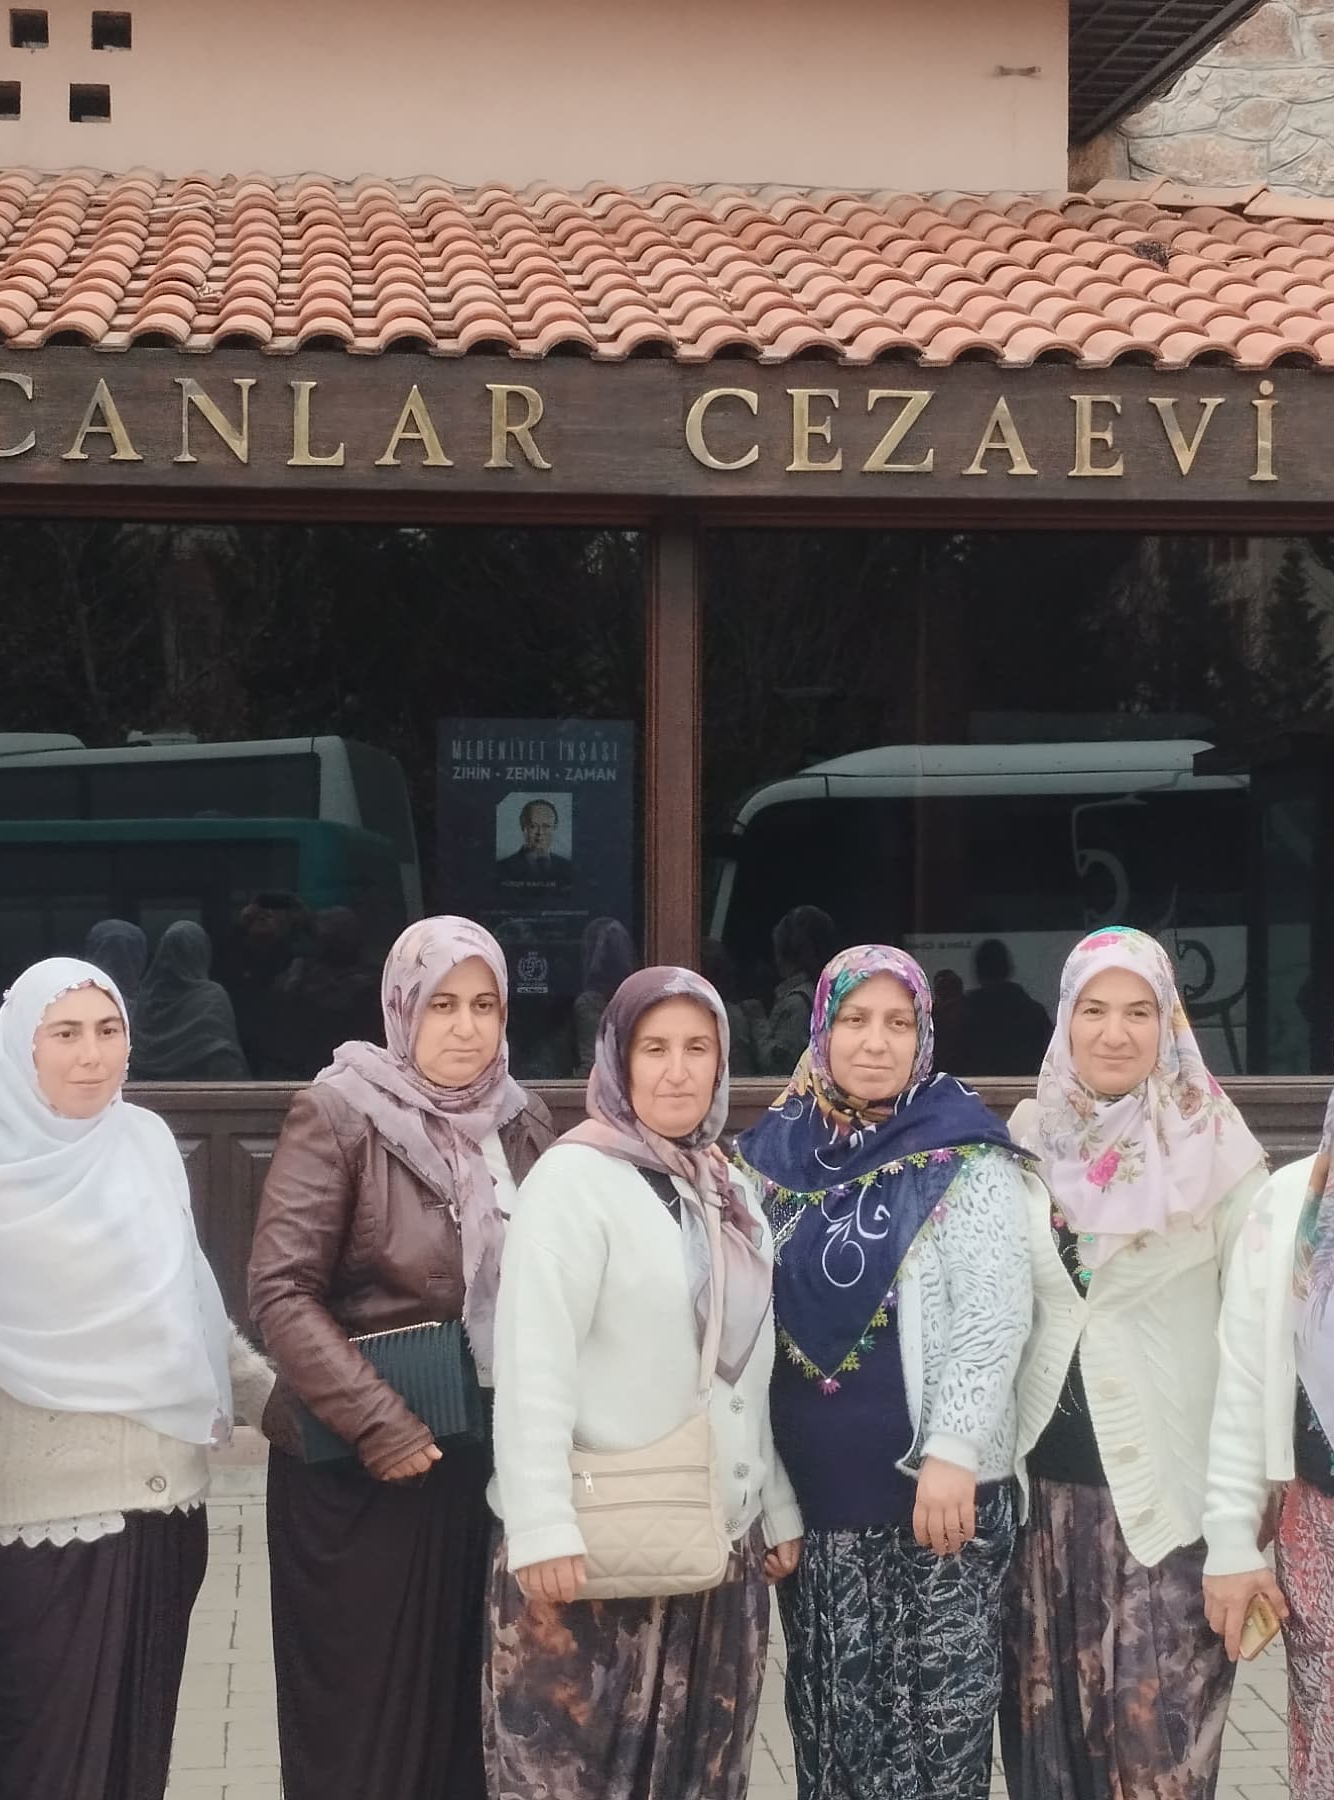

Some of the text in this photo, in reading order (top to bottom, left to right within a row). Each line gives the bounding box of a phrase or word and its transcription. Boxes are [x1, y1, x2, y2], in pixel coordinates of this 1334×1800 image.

[684, 379, 1279, 483] CEZAEVİ
[505, 764, 550, 781] ZEMİN
[564, 767, 617, 782] ZAMAN
